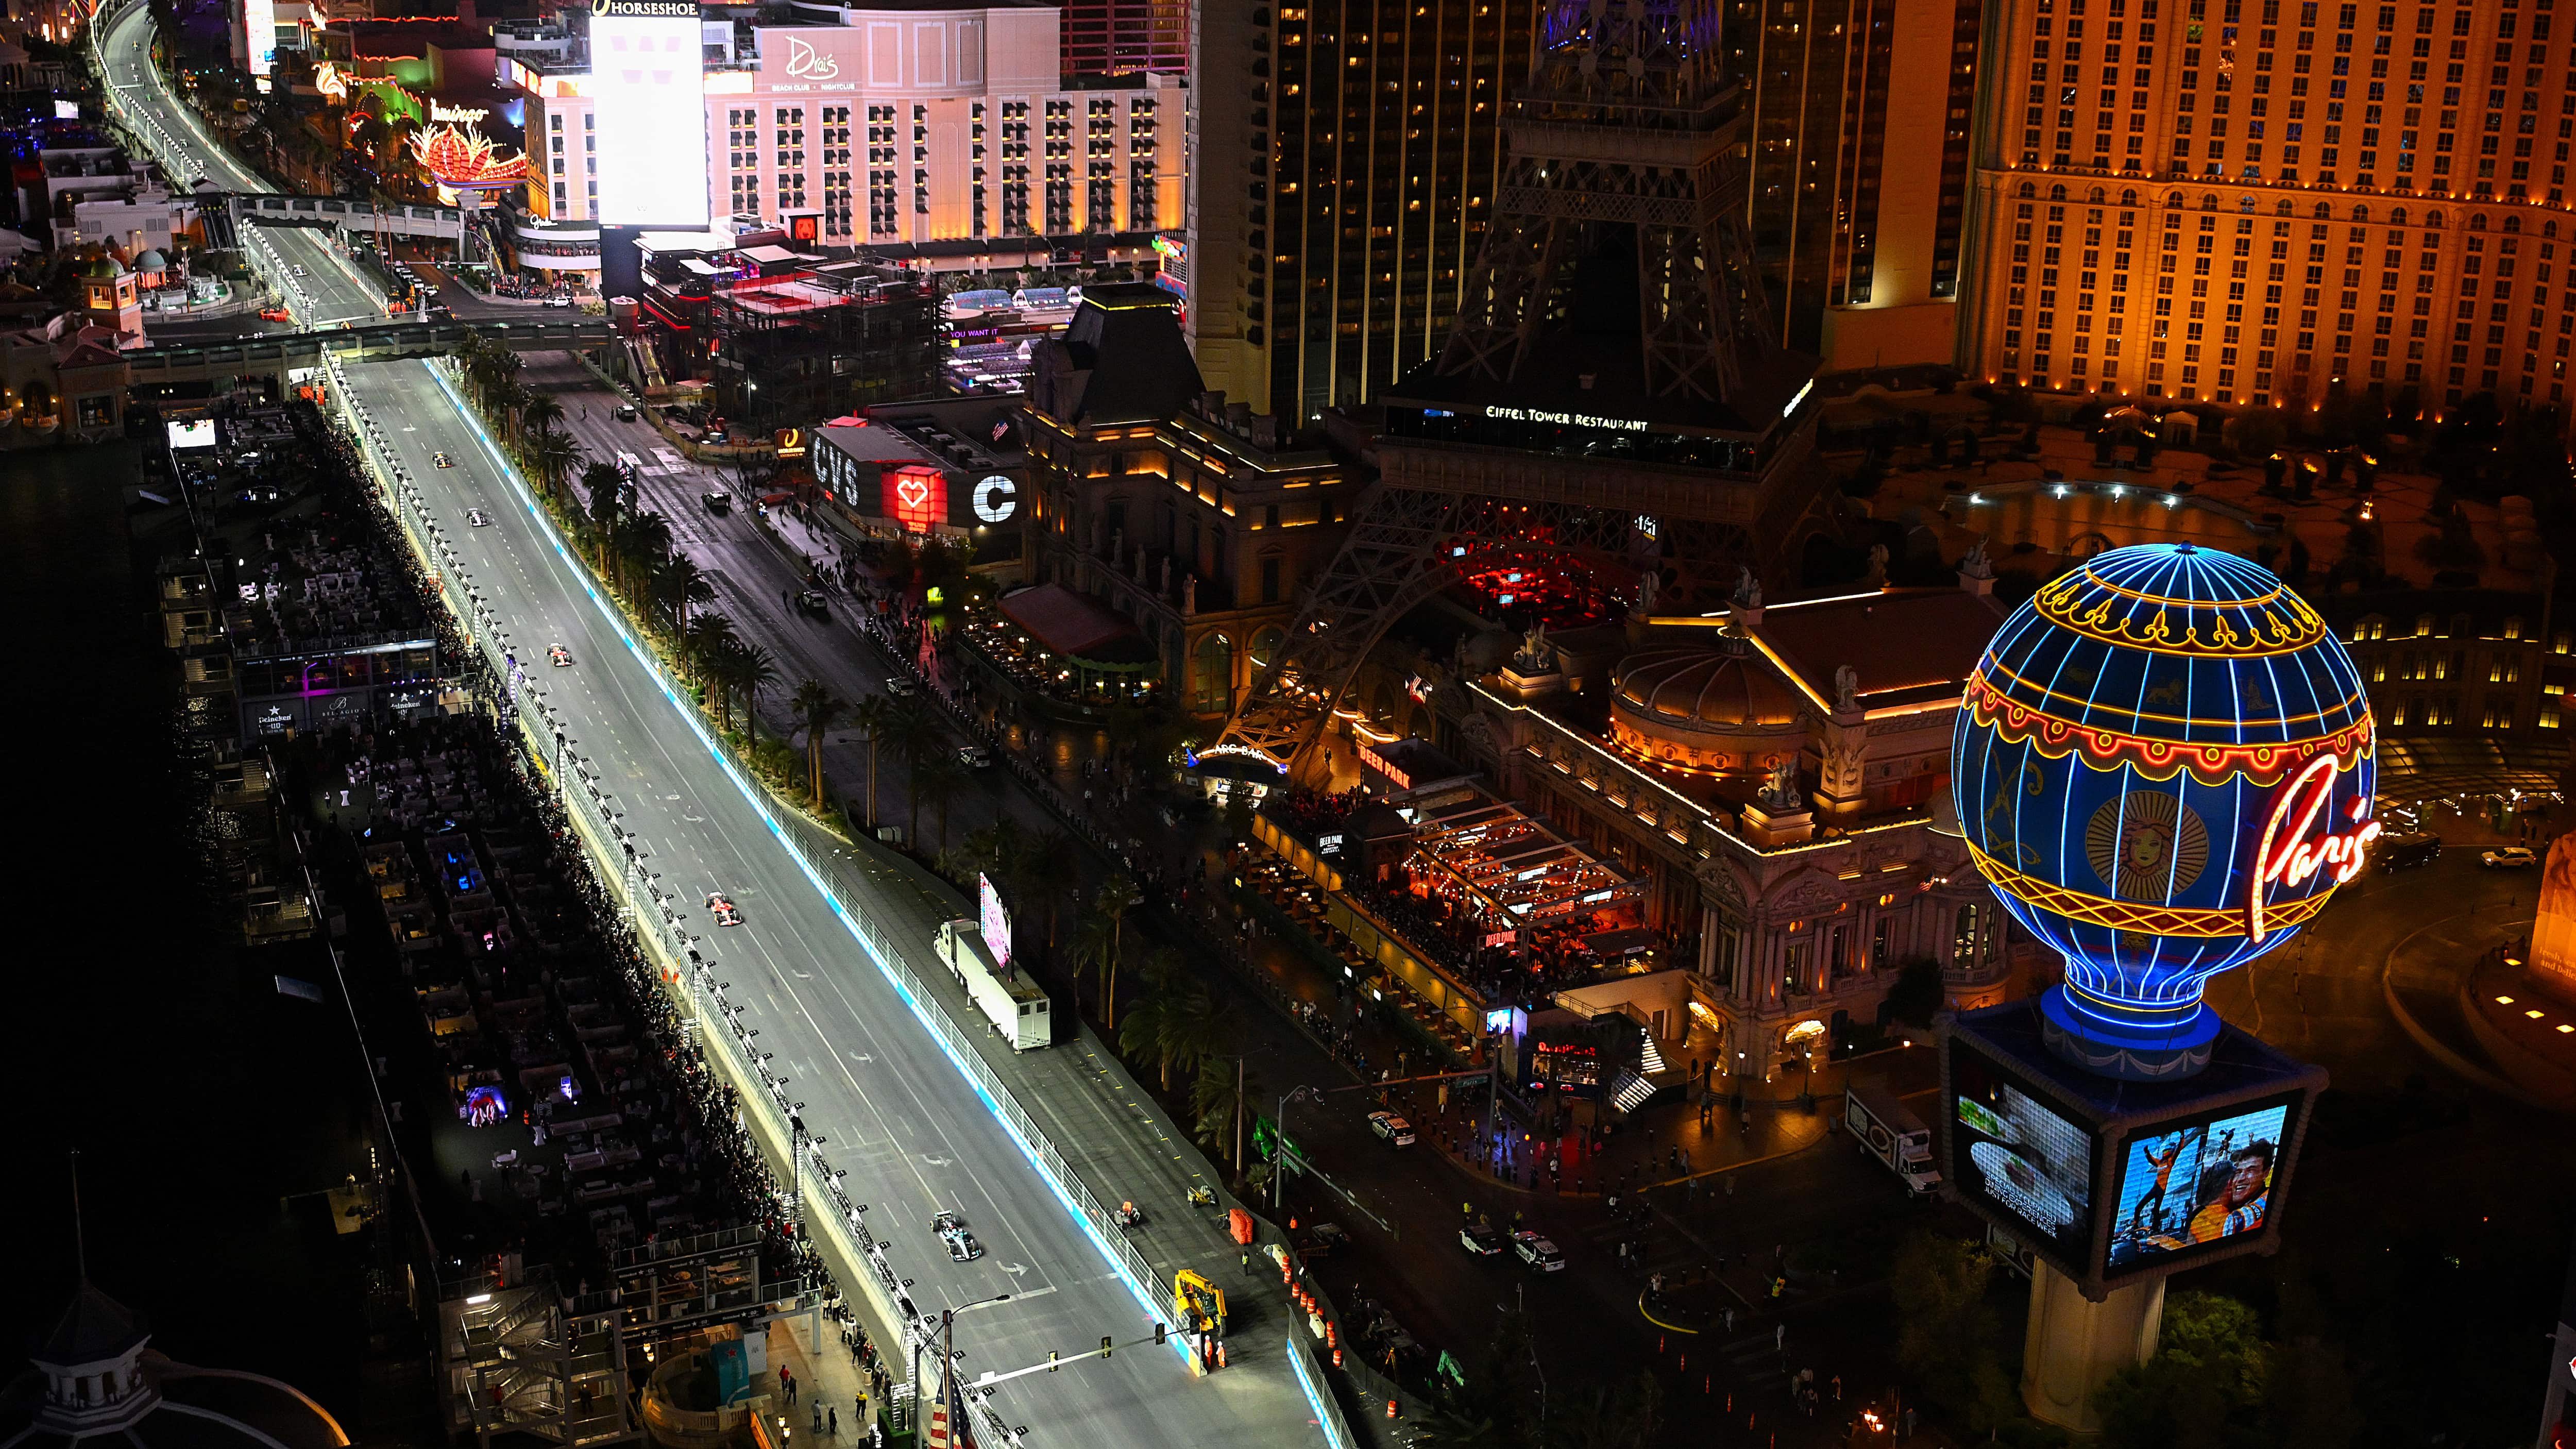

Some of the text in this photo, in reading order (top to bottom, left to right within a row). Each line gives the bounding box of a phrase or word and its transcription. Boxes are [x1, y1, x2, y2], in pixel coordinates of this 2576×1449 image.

[611, 2, 698, 15] HORSESHOE
[786, 35, 839, 80] Drai's
[1486, 406, 1648, 431] EIFFEL TOWER RESTAURANT
[814, 436, 859, 506] CVS
[1360, 745, 1410, 789] BEER PARK
[1320, 835, 1342, 847] BEER PARK
[2244, 753, 2381, 943] Paris
[1486, 931, 1516, 947] BEER PARK
[1985, 1177, 2056, 1231] DINING EXPERIENCES
[1985, 1186, 2057, 1240] JUST FOR RACE WEEK
[1987, 1171, 2056, 1223] SPECIALLY CURATED
